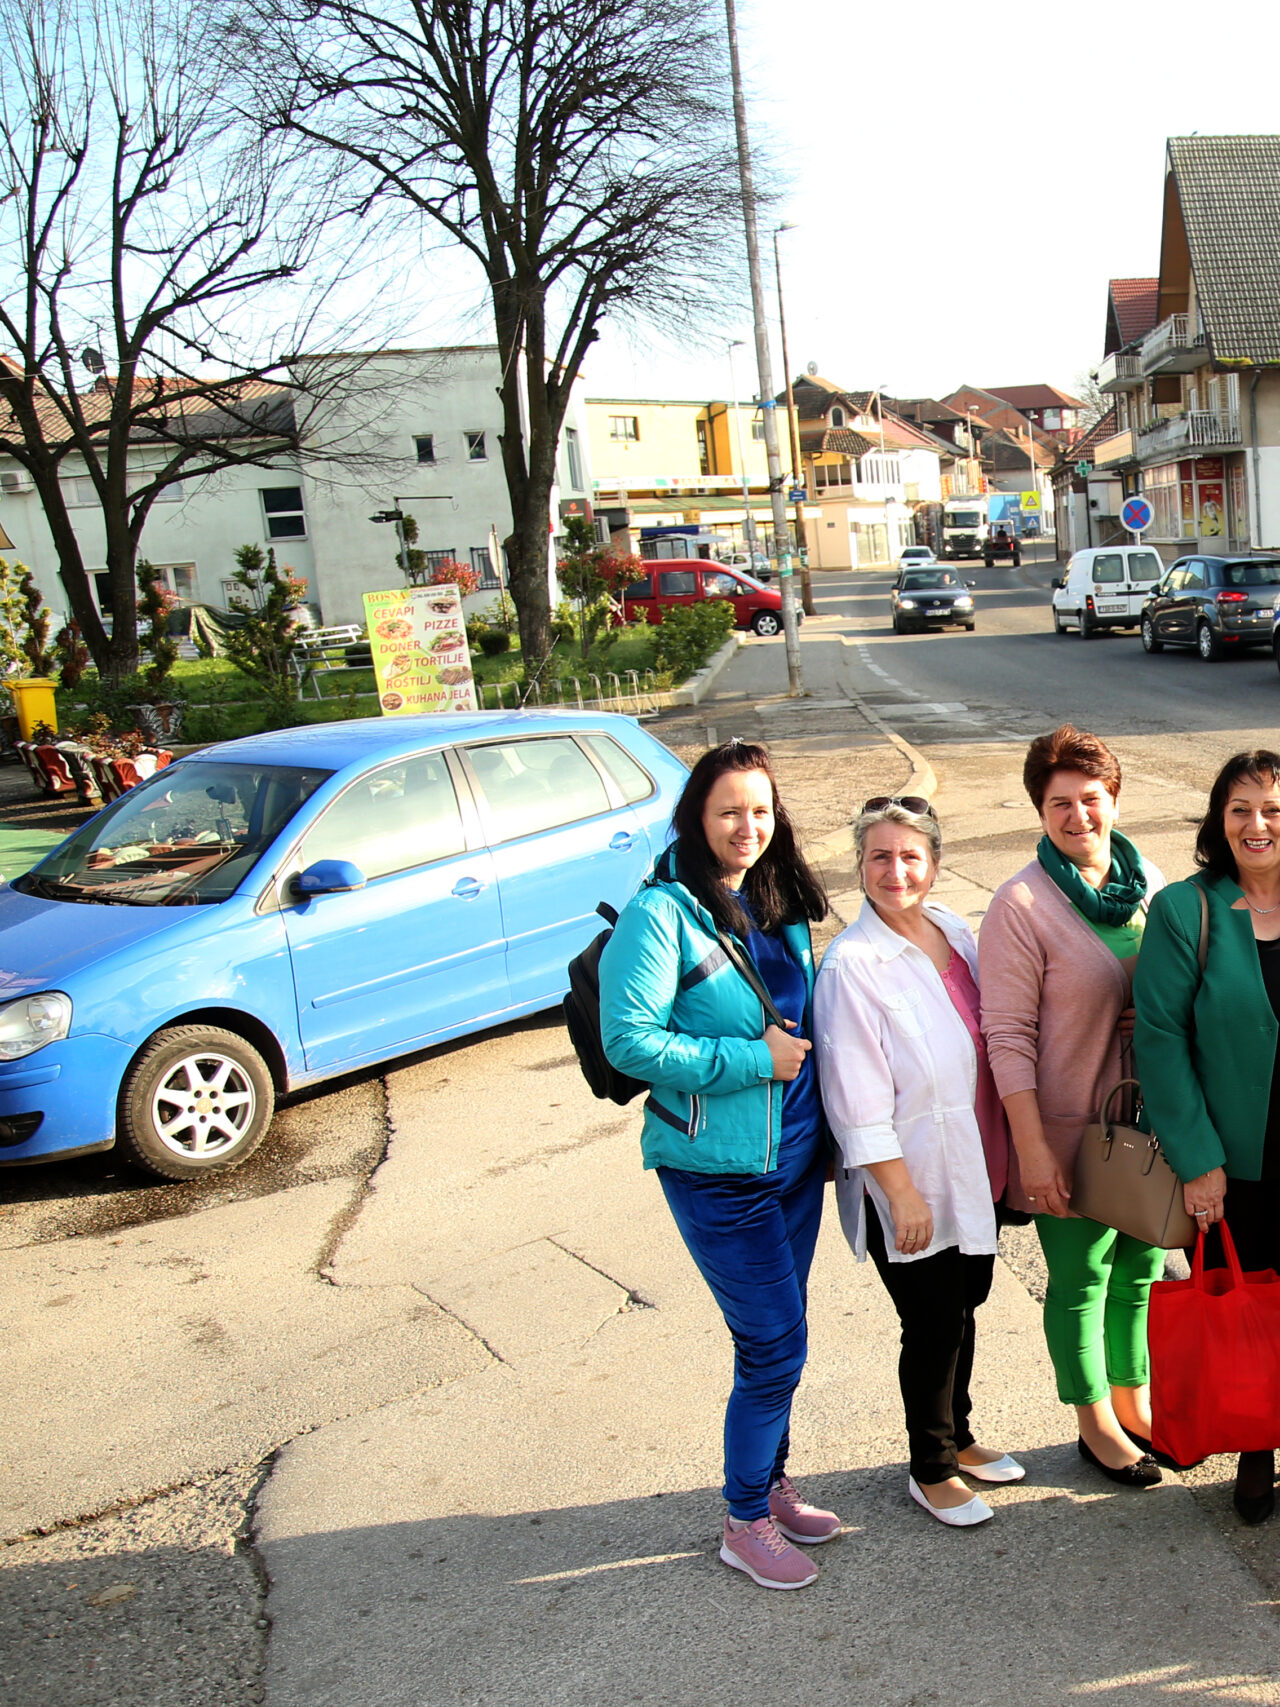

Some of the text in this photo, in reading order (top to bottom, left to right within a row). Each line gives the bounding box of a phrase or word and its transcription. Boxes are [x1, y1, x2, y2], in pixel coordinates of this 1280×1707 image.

[368, 591, 409, 603] BOSNA
[424, 618, 459, 631] PIZZE
[380, 640, 421, 654] DONER
[414, 653, 465, 668] TORTILJE
[386, 675, 431, 689] ROŠTILJ
[406, 688, 471, 704] KUHANA JELA
